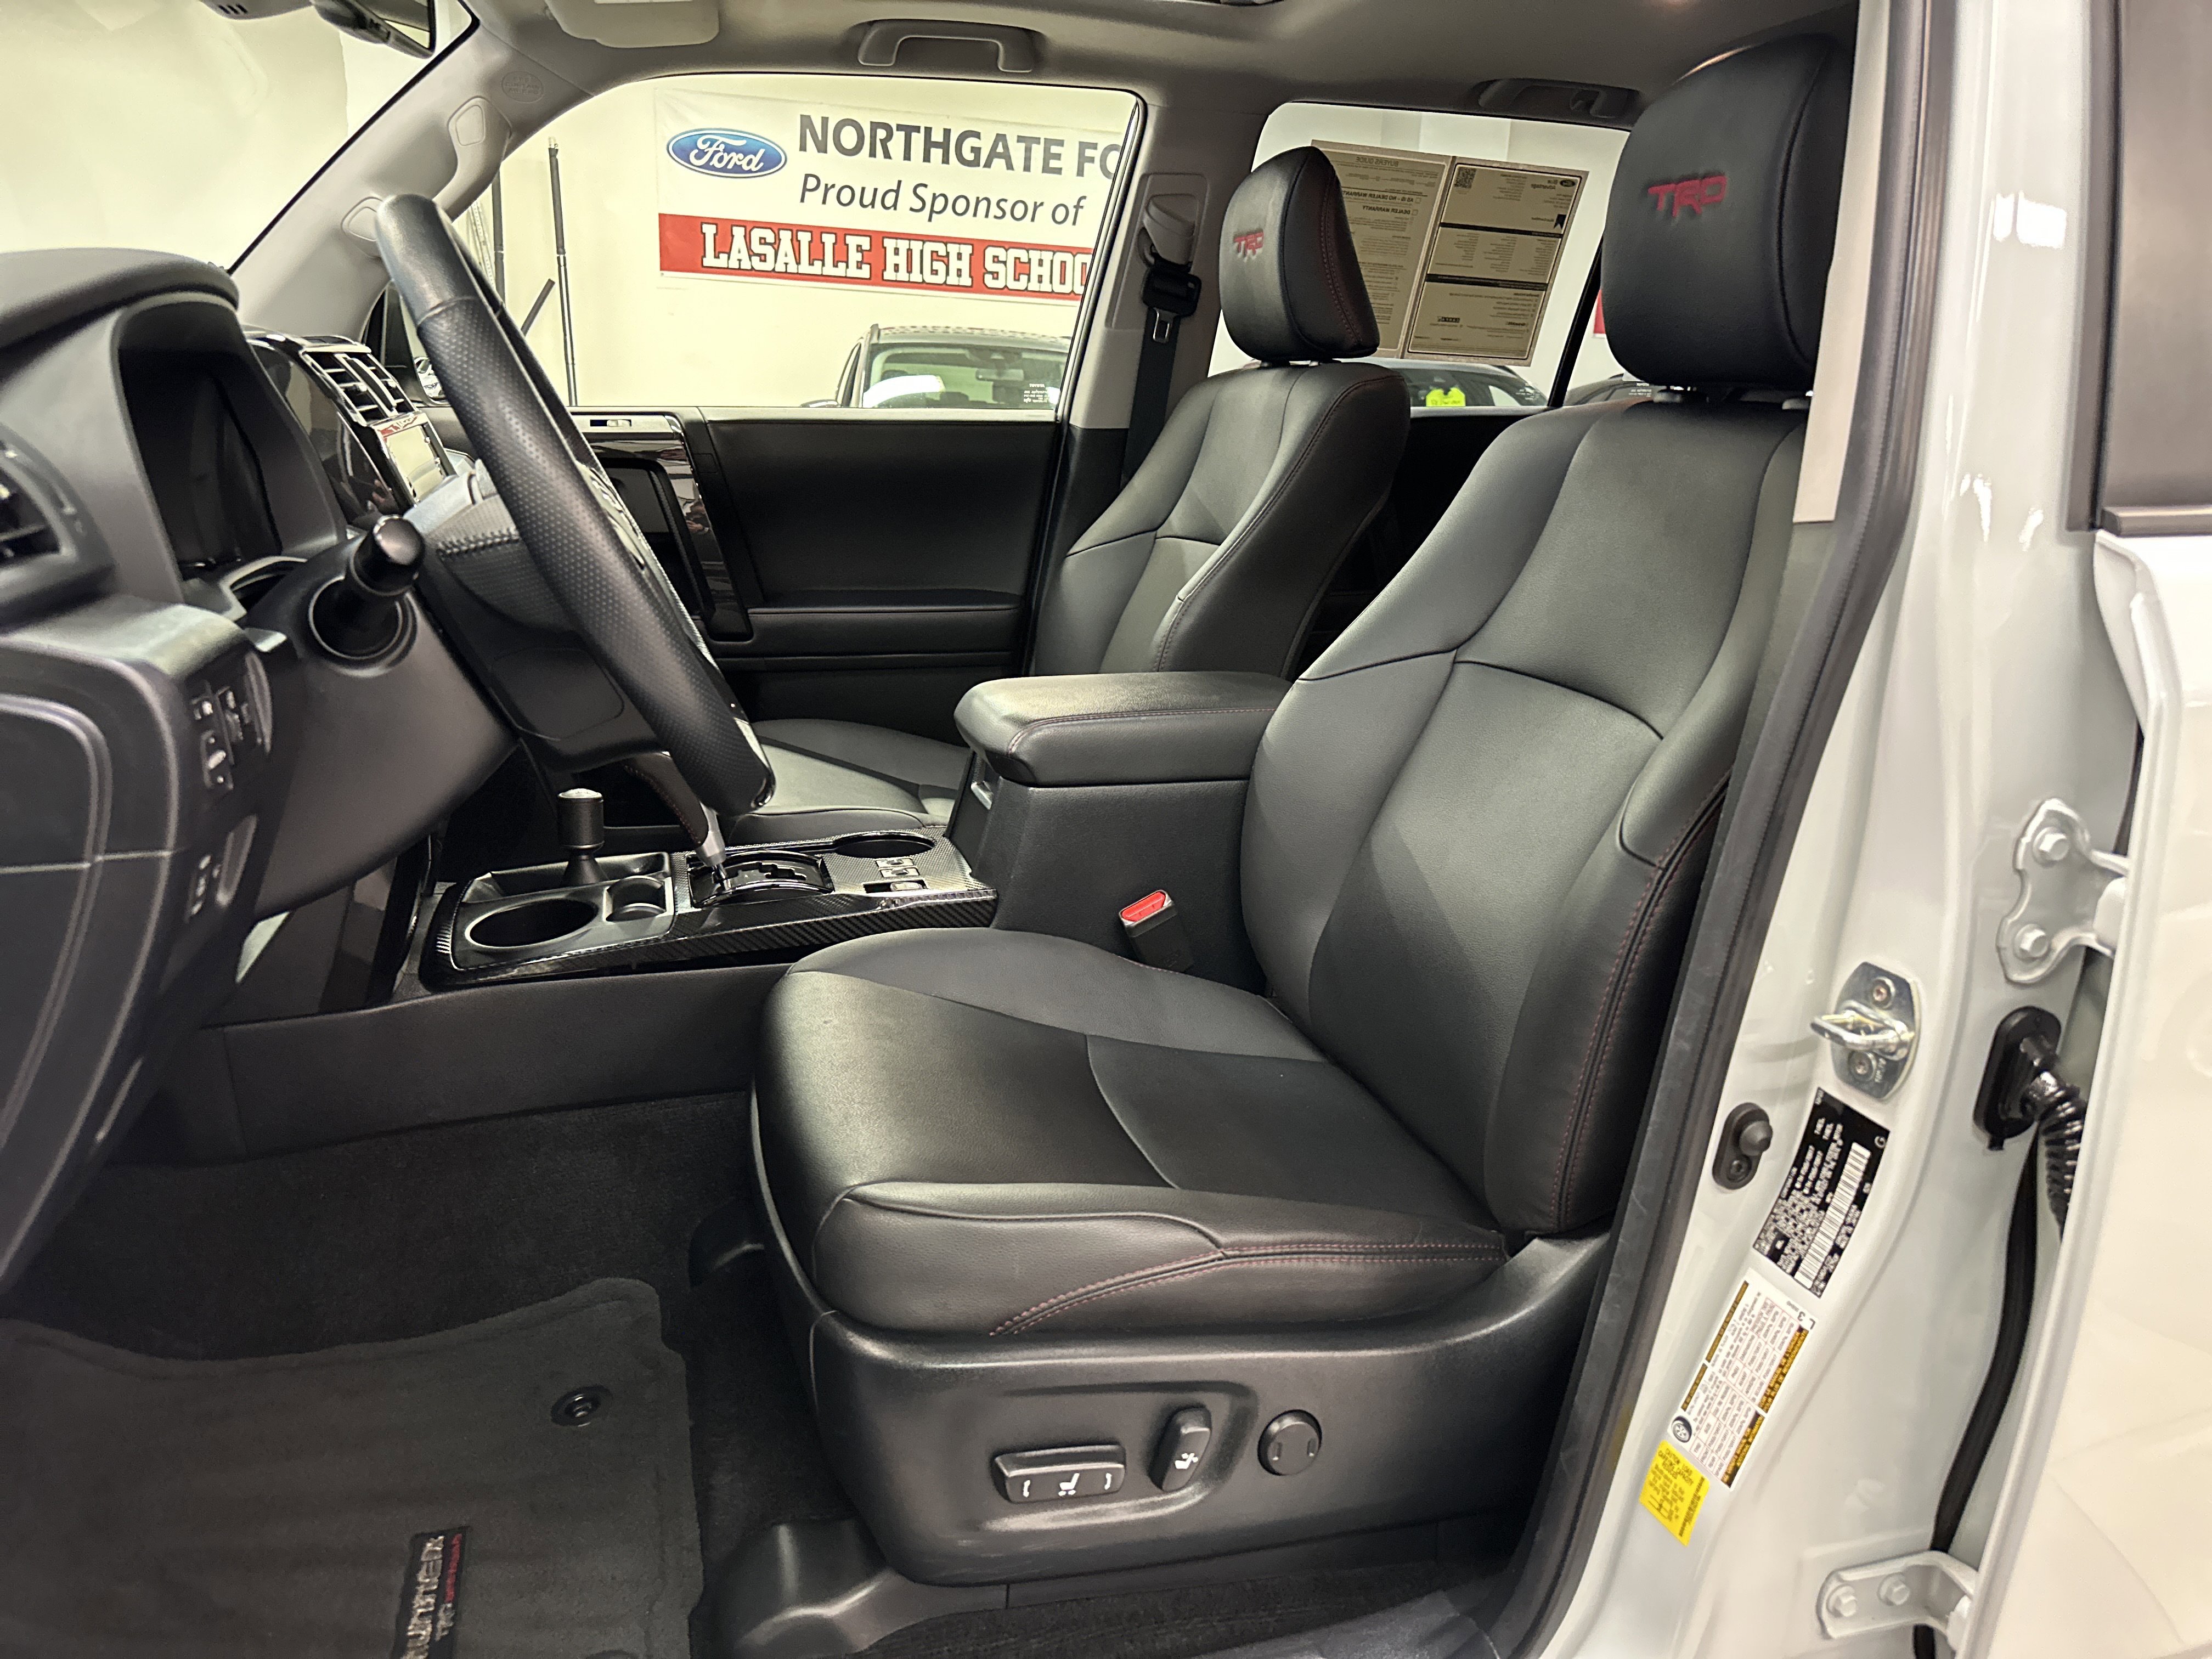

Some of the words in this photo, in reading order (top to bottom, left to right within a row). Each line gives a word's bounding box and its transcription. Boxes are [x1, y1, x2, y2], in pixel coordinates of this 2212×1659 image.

[689, 132, 766, 173] Ford
[799, 114, 1064, 175] NORTHGATE
[799, 173, 902, 211] Proud
[910, 184, 1044, 223] Sponsor
[1051, 196, 1086, 226] of
[1648, 176, 1728, 218] TRD
[701, 222, 872, 280] LASALLE
[882, 238, 973, 287] HIGH
[1234, 232, 1264, 256] TRD
